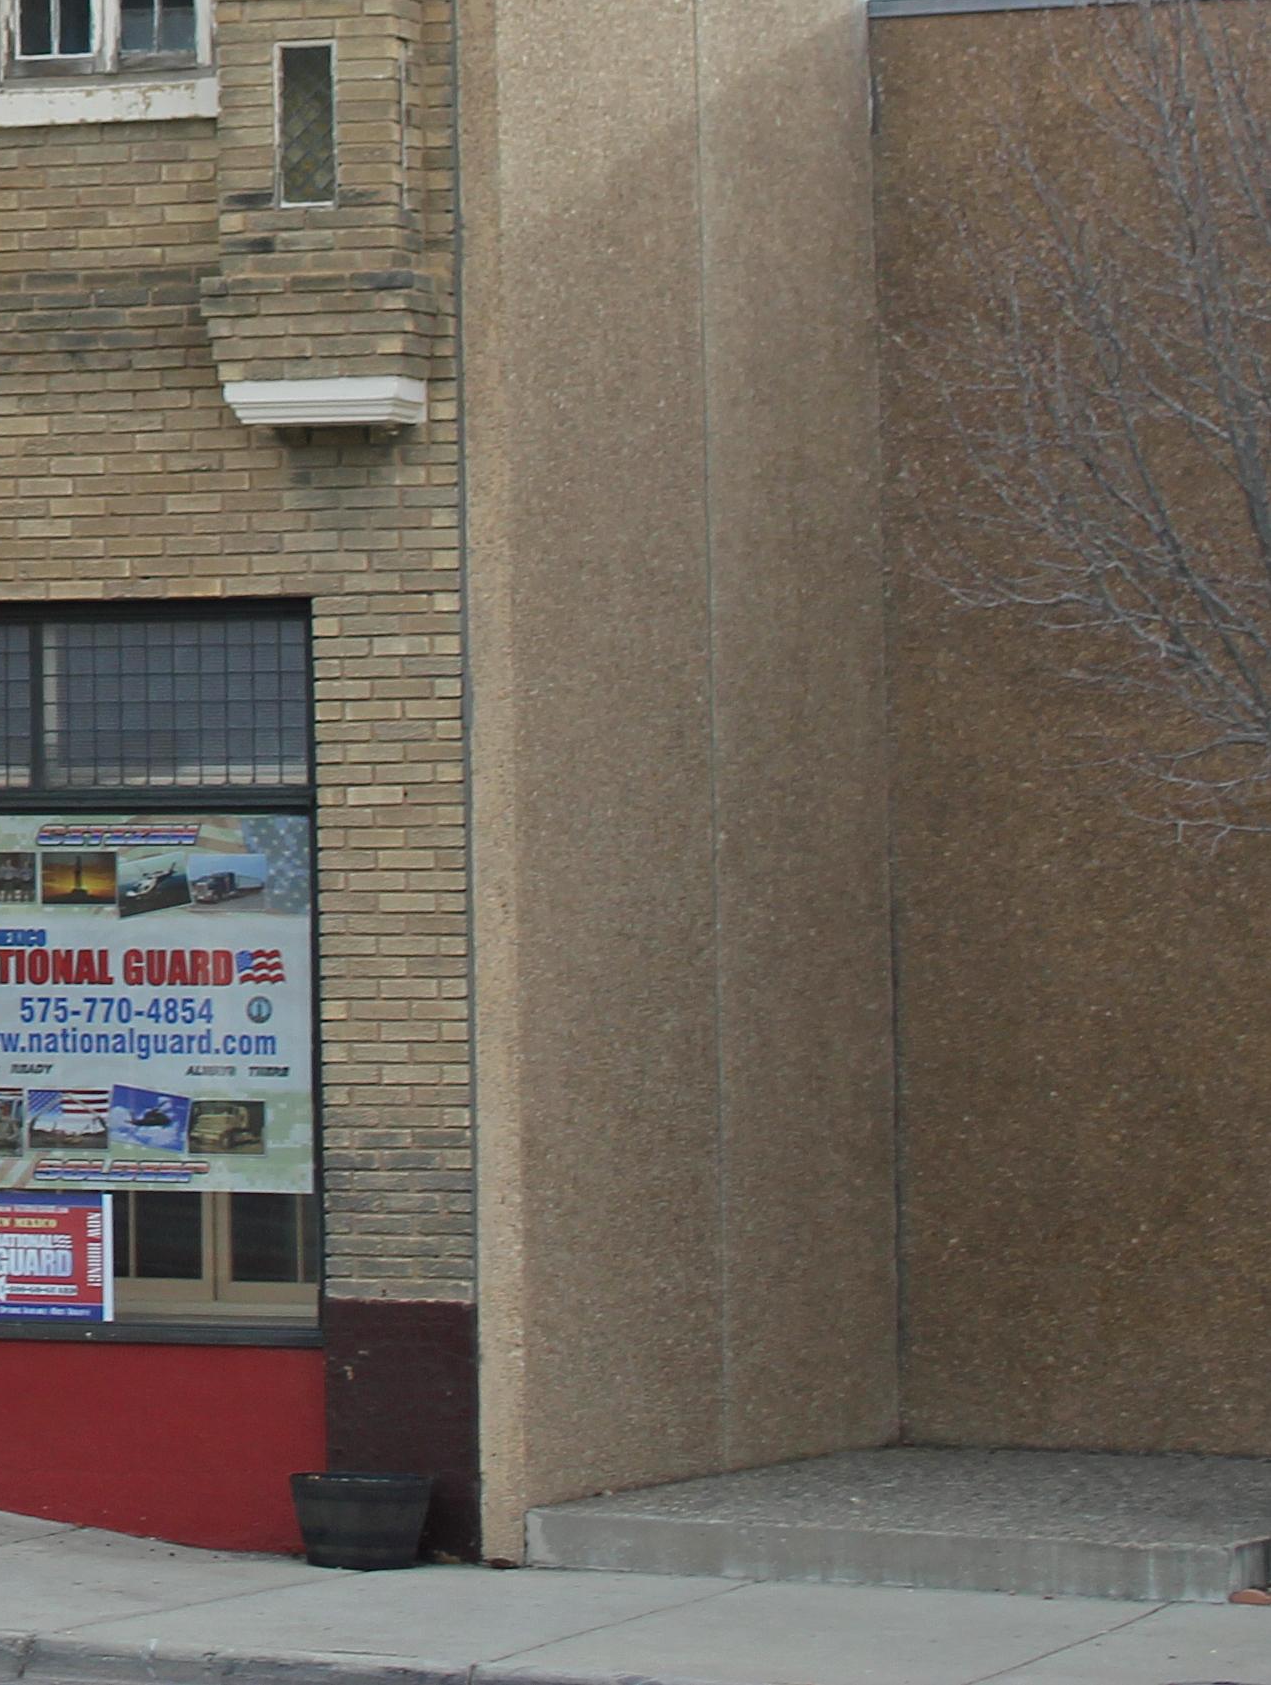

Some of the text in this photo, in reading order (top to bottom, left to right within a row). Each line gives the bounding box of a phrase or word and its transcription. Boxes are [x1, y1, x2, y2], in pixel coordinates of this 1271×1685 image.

[123, 949, 234, 987] GUARD
[19, 996, 214, 1024] 575-770-4854
[86, 1212, 102, 1239] NOW
